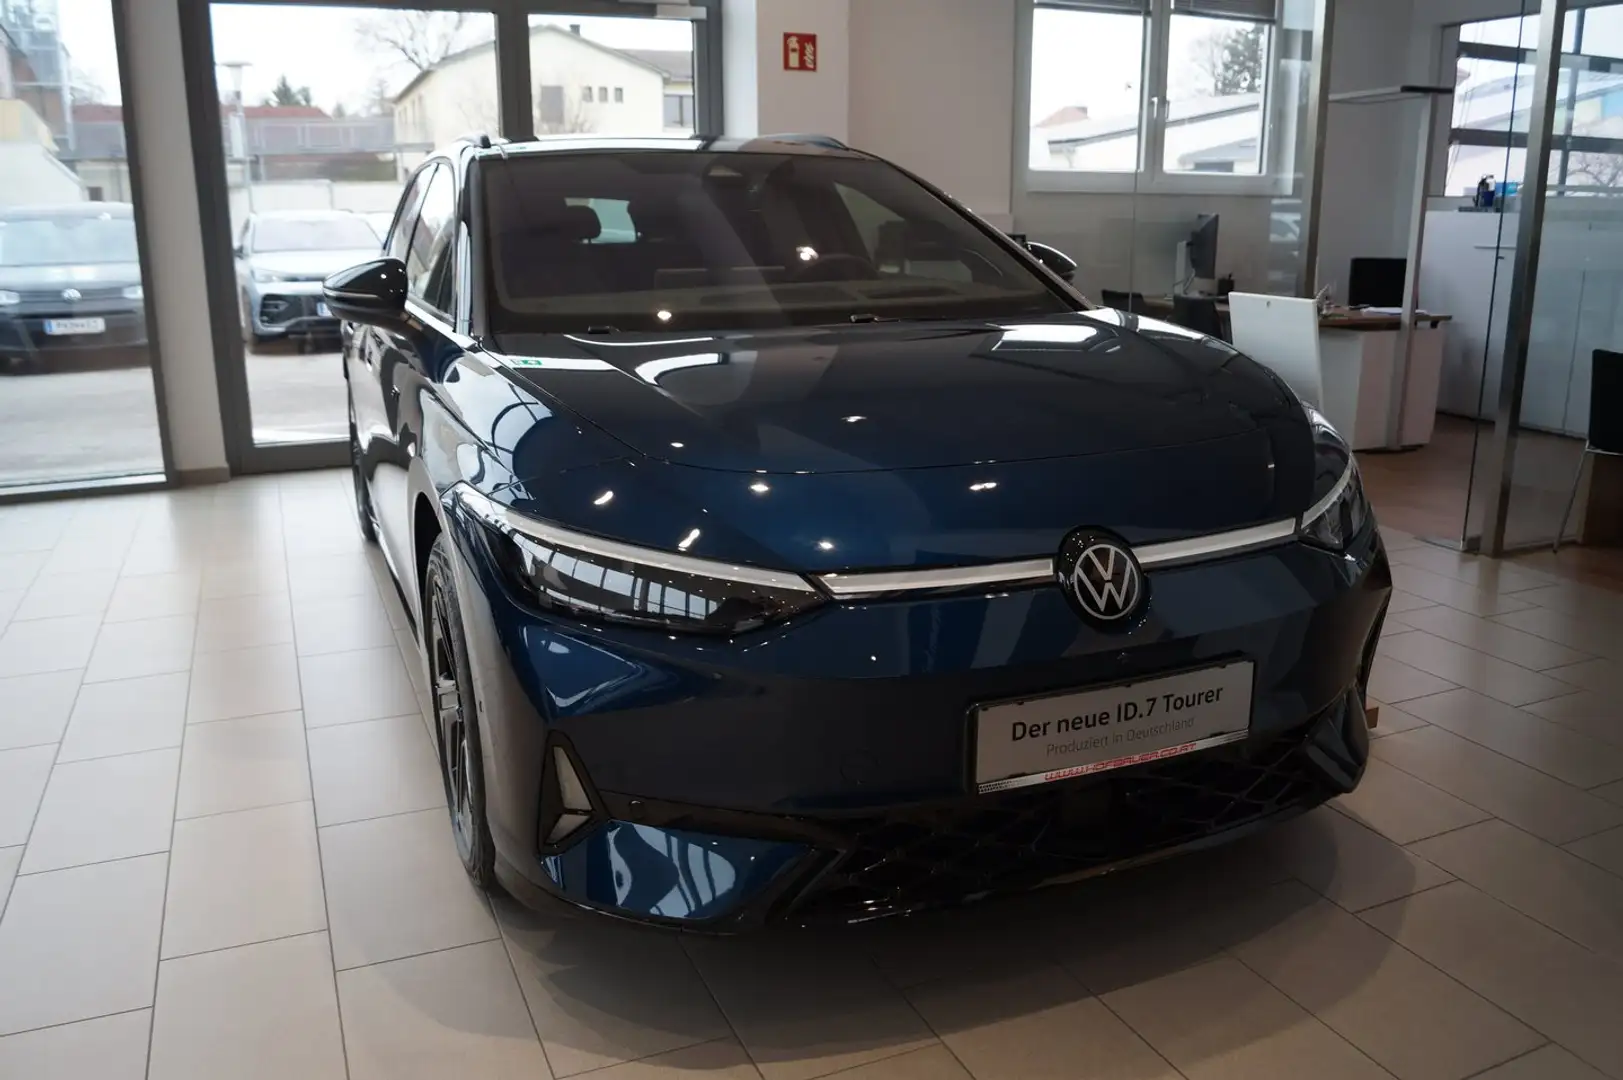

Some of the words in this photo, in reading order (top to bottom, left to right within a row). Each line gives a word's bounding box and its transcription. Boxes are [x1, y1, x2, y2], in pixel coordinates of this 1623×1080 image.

[1075, 545, 1136, 618] VW
[1012, 721, 1051, 742] Der
[1057, 711, 1110, 733] neue
[1117, 697, 1158, 722] ID.7
[1162, 687, 1223, 712] Tourer
[1046, 736, 1108, 757] Produziert
[1113, 732, 1123, 745] in
[1127, 717, 1195, 741] Deutschland
